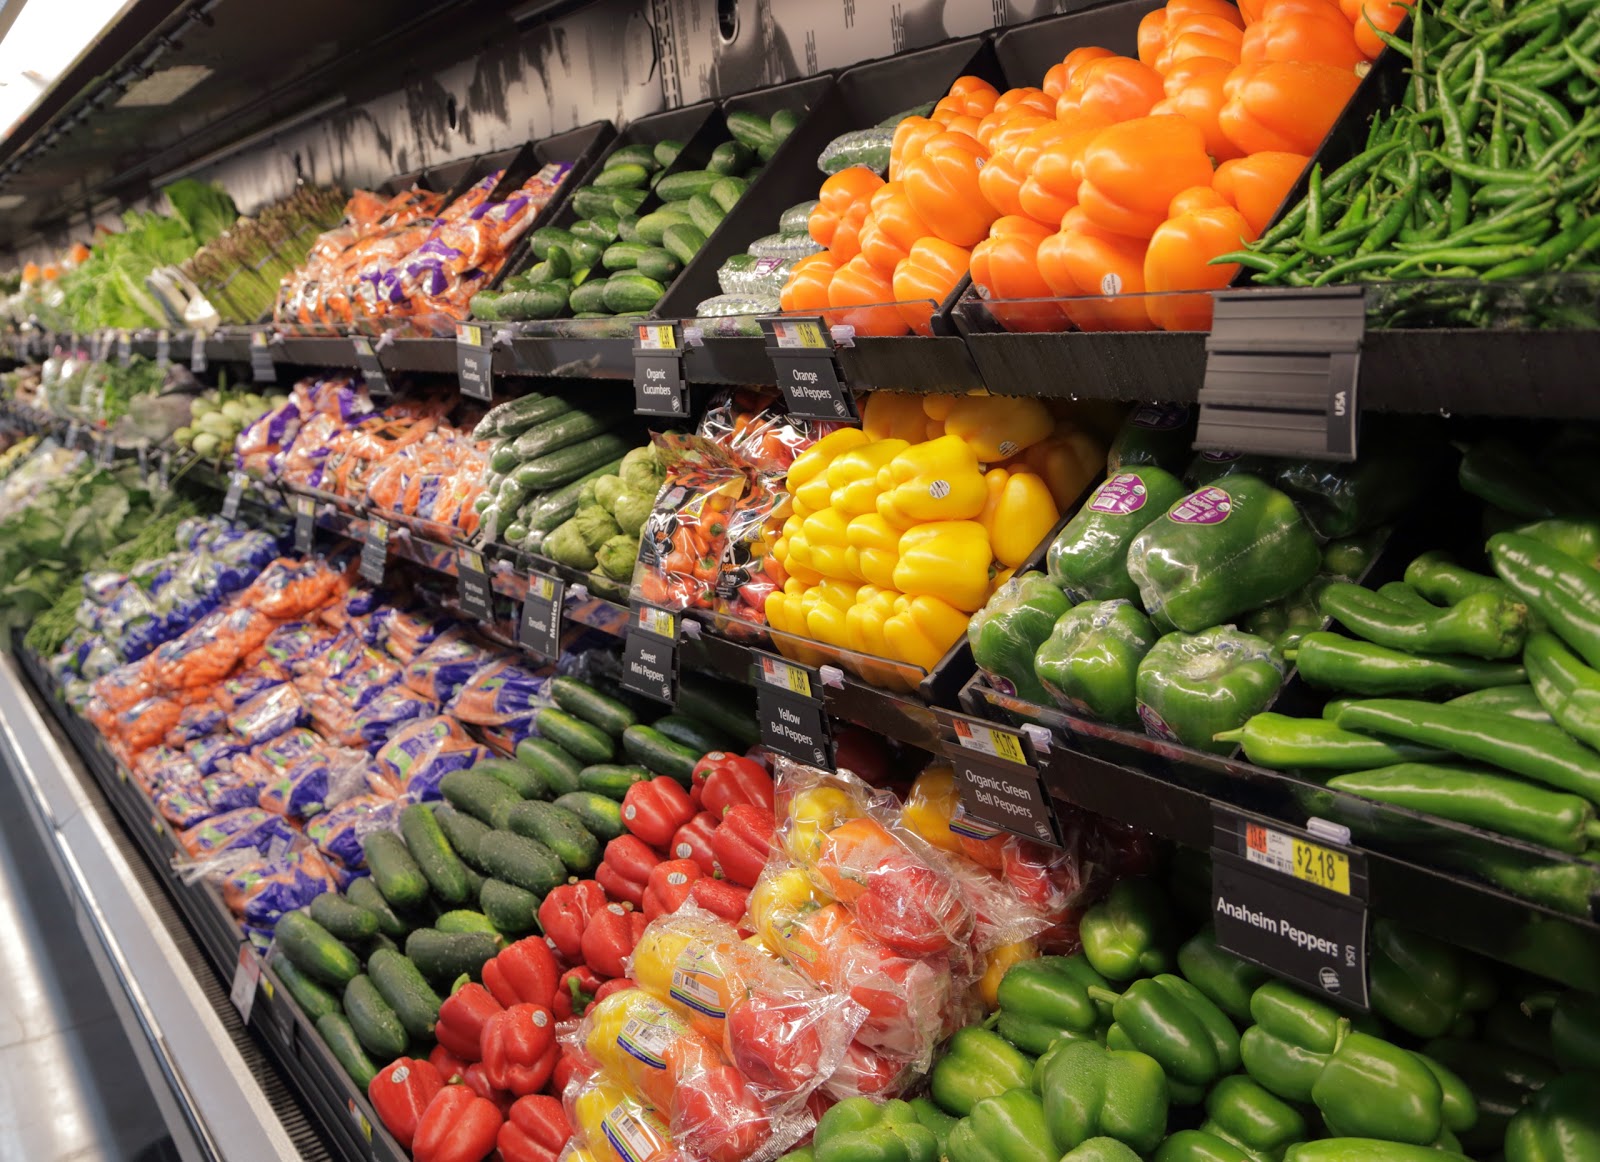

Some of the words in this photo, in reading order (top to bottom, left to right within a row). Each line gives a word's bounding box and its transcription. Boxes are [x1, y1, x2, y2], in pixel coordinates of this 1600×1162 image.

[646, 368, 666, 382] Organic
[792, 369, 818, 384] Orange
[642, 383, 671, 396] Cucumbers
[790, 386, 804, 398] Bell
[804, 386, 832, 401] Peppers
[1334, 391, 1346, 417] USA
[549, 601, 558, 639] Mexico
[640, 649, 657, 664] Sweet
[630, 661, 642, 675] Mini
[643, 665, 665, 682] Peppers
[778, 707, 800, 725] Yellow
[771, 721, 784, 736] Bell
[784, 725, 814, 746] Peppers
[992, 730, 1018, 757] $1.79
[965, 769, 1002, 791] Organic
[1001, 780, 1032, 801] Green
[975, 789, 993, 806] Bell
[993, 795, 1033, 818] Peppers
[1297, 845, 1335, 882] $2.18
[1217, 896, 1277, 934] Anaheim
[1280, 919, 1338, 957] Peppers
[1345, 944, 1356, 967] USA
